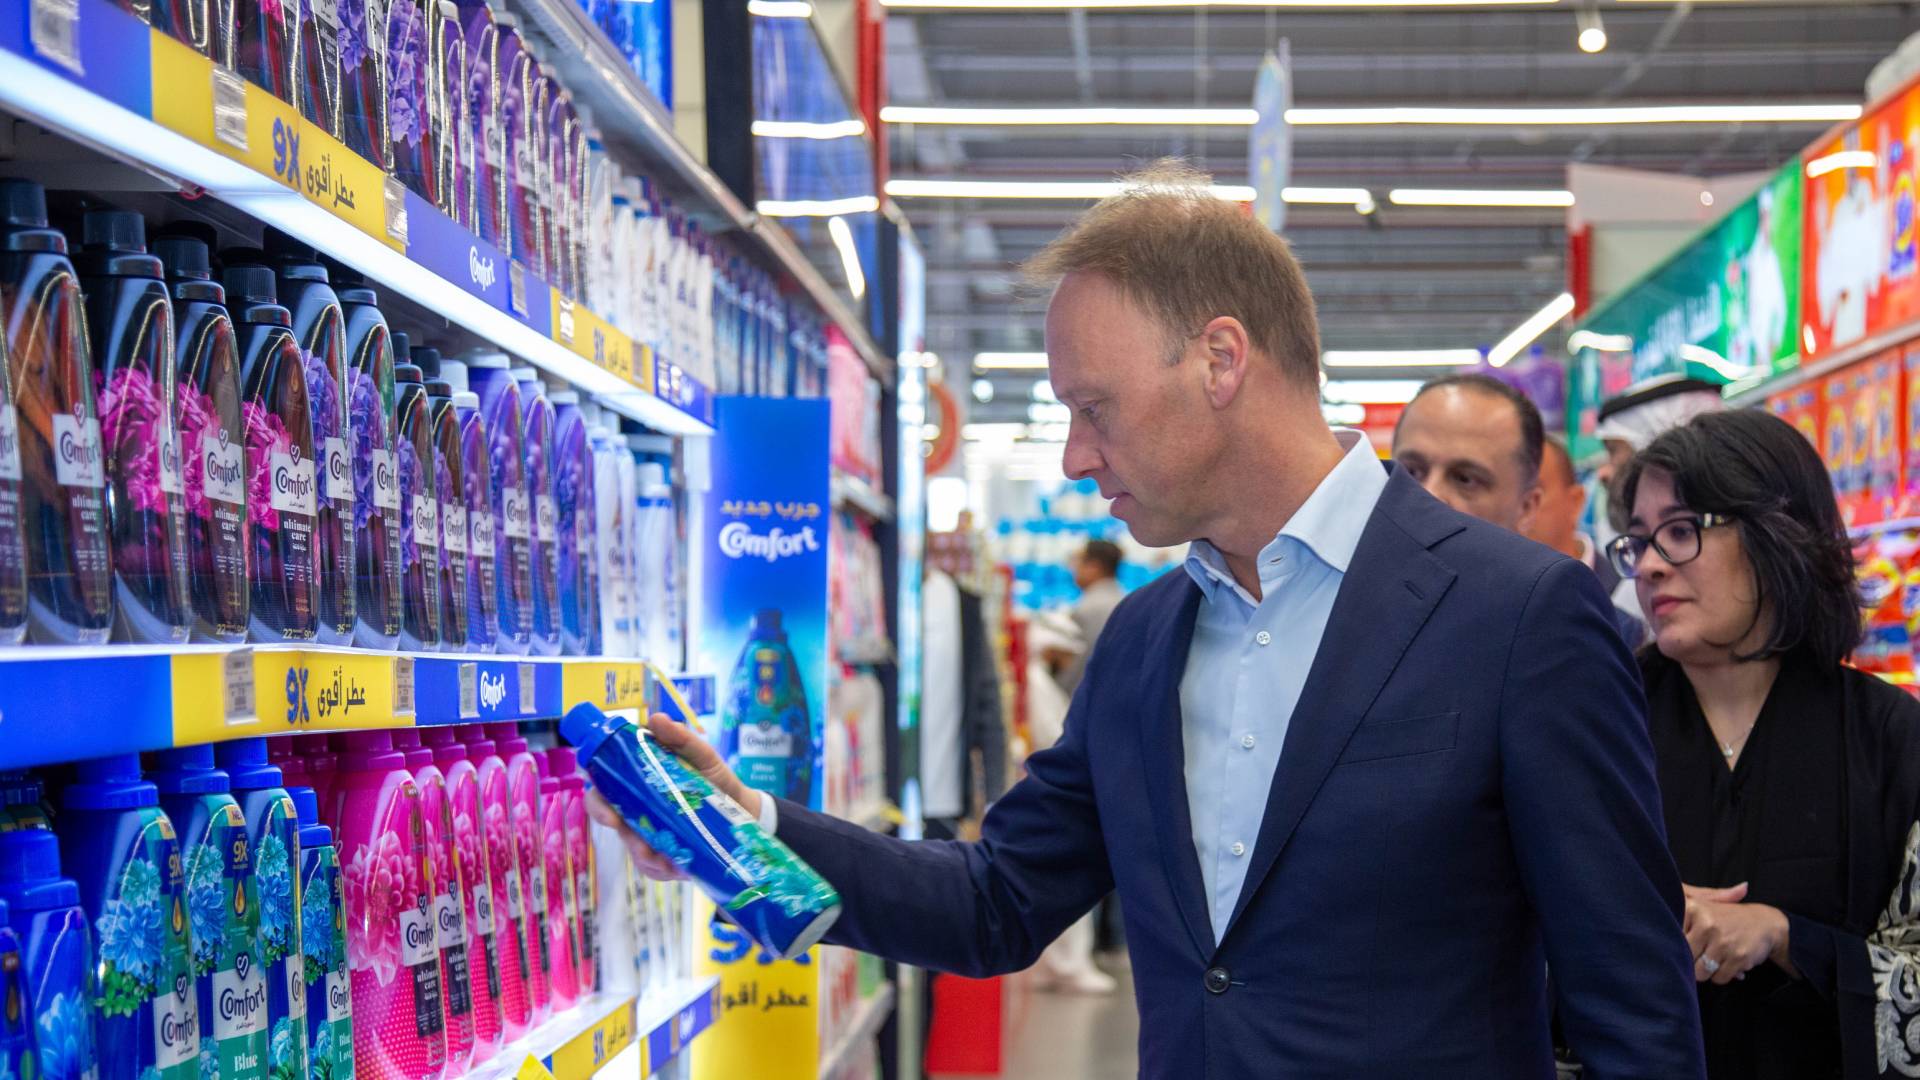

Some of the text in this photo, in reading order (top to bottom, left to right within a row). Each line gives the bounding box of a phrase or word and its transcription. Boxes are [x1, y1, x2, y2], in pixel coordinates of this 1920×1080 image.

[272, 117, 301, 191] 9X
[306, 153, 355, 209] عطر أقوى
[469, 245, 496, 291] Comfort
[207, 451, 240, 487] Comfort
[275, 466, 313, 499] Comfort
[214, 507, 240, 522] ultimate
[221, 521, 236, 532] care
[283, 519, 311, 533] ultimate
[291, 531, 307, 541] care
[719, 521, 820, 562] Comfort
[282, 628, 293, 639] 22
[286, 666, 310, 724] 9X
[317, 665, 342, 718] أقوى
[344, 677, 366, 716] عطر
[480, 670, 506, 711] Comfort
[233, 841, 248, 862] 9X
[406, 922, 435, 948] Comfo
[219, 982, 265, 1021] Comfort
[724, 979, 758, 1010] أقو
[234, 1052, 258, 1073] Blue
